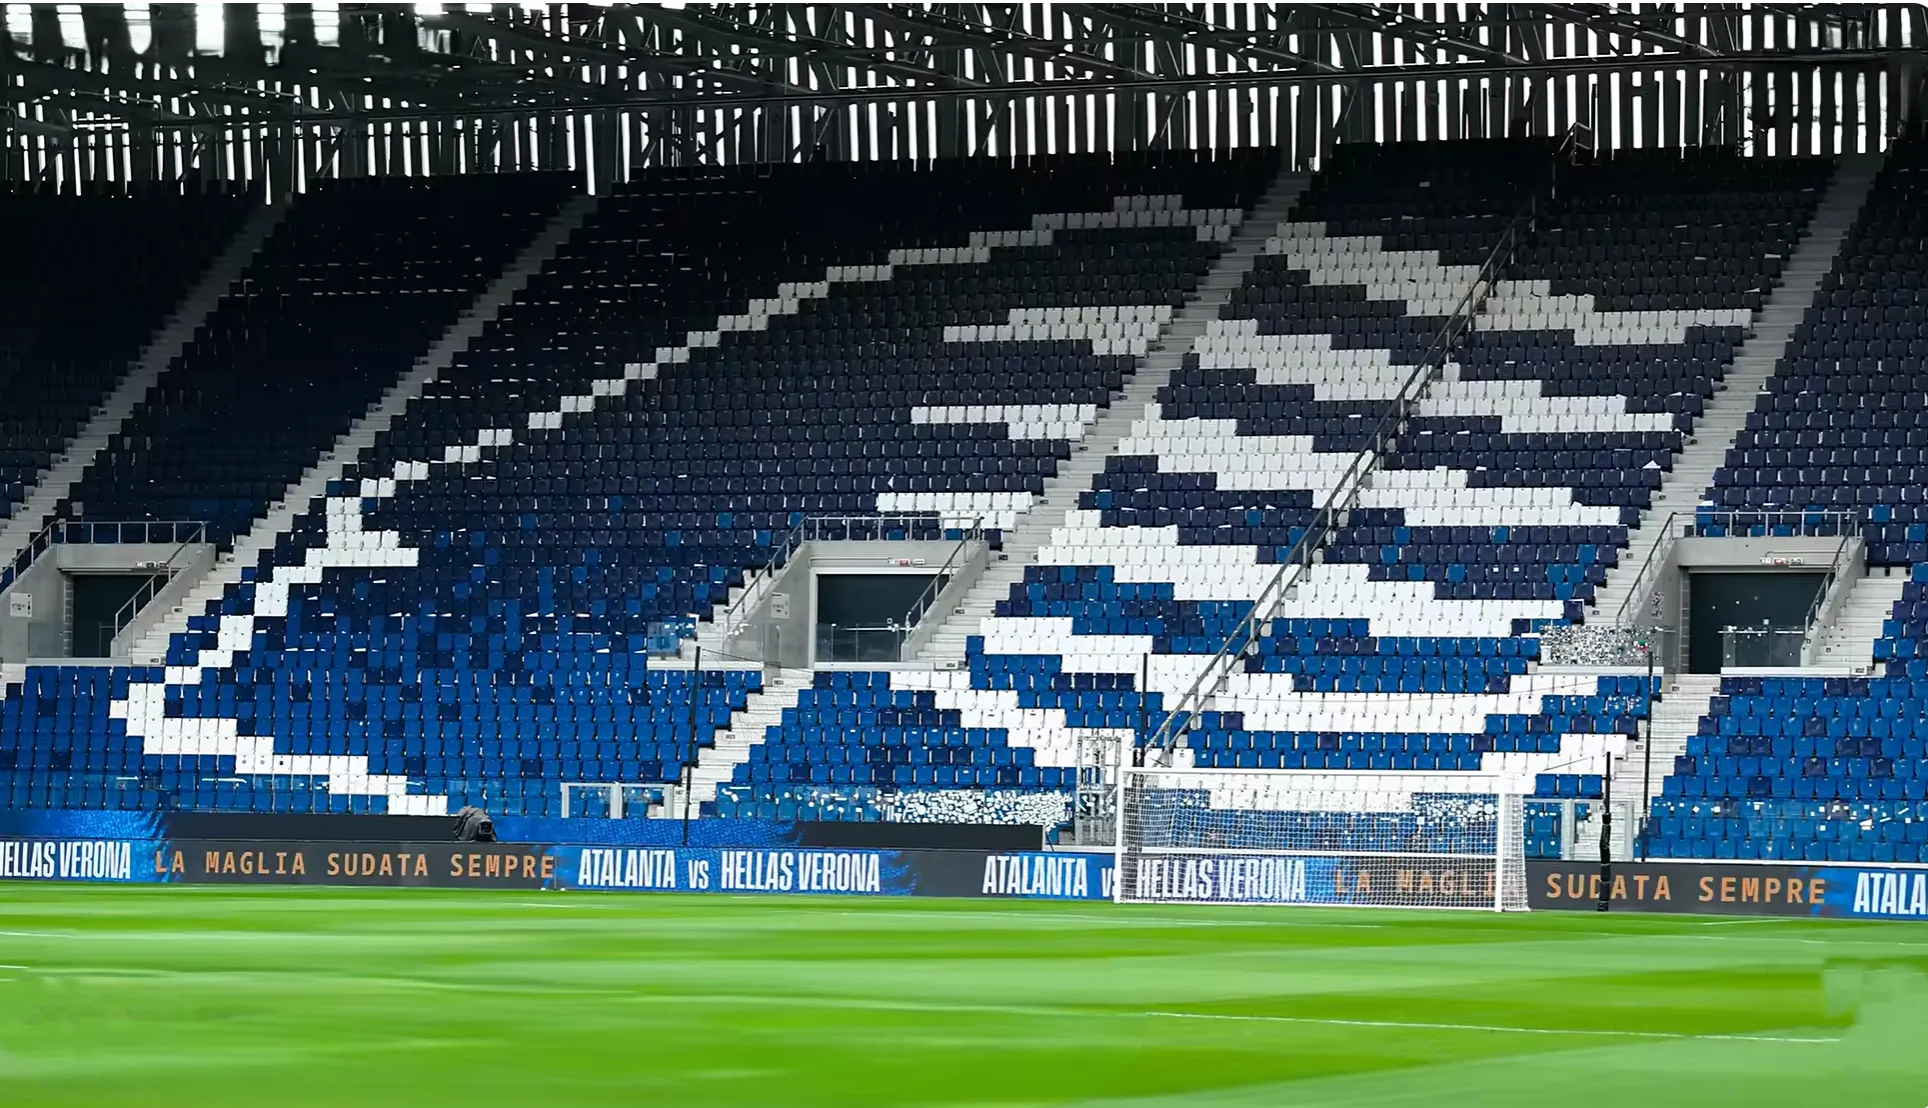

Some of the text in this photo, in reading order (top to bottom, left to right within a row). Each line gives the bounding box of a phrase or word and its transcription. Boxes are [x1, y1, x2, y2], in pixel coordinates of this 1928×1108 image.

[60, 841, 131, 879] VERONA
[155, 850, 554, 878] LA MAGLIA SUDATA SEMPRE
[578, 849, 676, 888] ATALANTA
[721, 851, 794, 891] HELLAS
[798, 852, 880, 892] VERONA
[982, 855, 1088, 897] ATALANTA
[1136, 859, 1213, 898] HELLAS
[1218, 859, 1305, 900] VERONA
[1396, 869, 1513, 897] MAGLI
[1546, 873, 1671, 900] SUDATA
[1699, 876, 1826, 904] SEMPRE
[1853, 872, 1928, 915] ATALA
